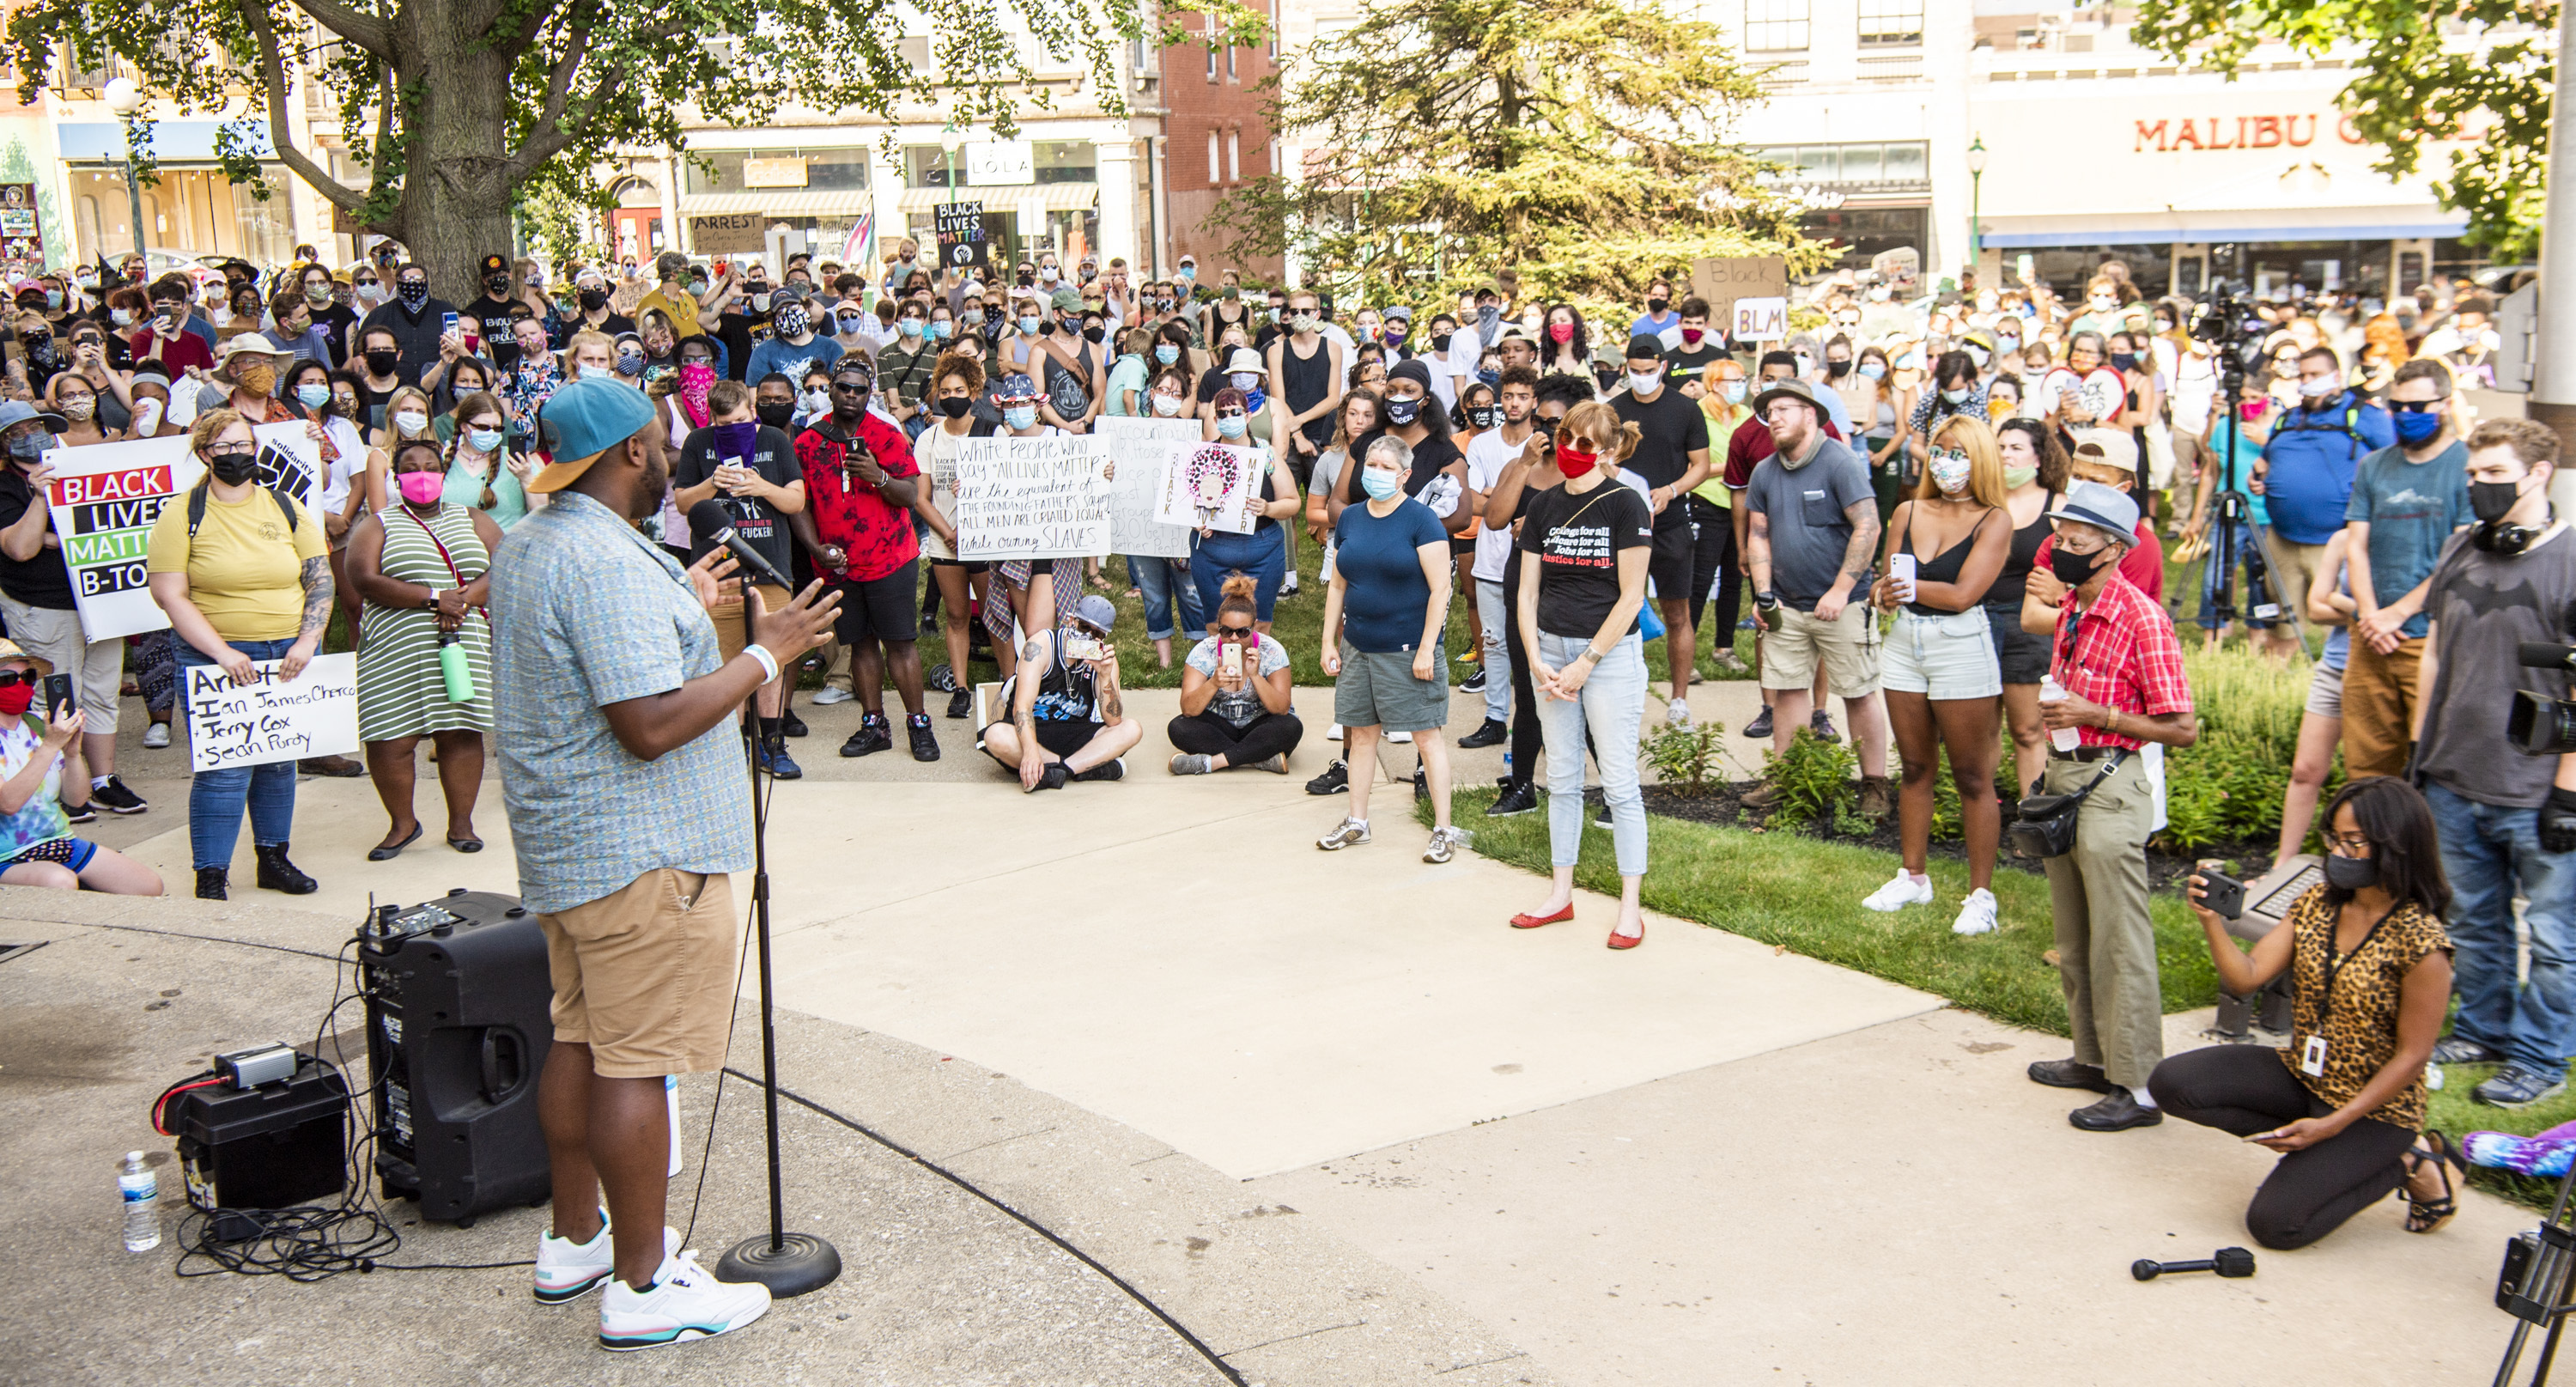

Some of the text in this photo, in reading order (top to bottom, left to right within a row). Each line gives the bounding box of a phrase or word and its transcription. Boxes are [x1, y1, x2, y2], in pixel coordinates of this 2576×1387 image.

[2135, 113, 2318, 152] MALIBU
[972, 160, 1030, 174] LOLA
[939, 201, 982, 218] BLACK
[695, 215, 759, 230] ARREST
[938, 216, 981, 232] LIVES
[937, 228, 986, 245] MATTER
[1710, 260, 1772, 284] Black
[618, 283, 644, 295] BLACK
[1739, 308, 1784, 335] BLM
[271, 438, 314, 476] solidarity
[957, 440, 1004, 462] White
[960, 464, 986, 481] say
[1017, 461, 1049, 478] LIVES
[64, 468, 163, 504] BLACK
[957, 477, 1100, 502] are the equivalent of
[960, 502, 980, 515] THE
[983, 500, 1035, 514] FOUNDING
[1035, 495, 1078, 511] FATHERS
[987, 514, 1011, 528] MEN
[1014, 513, 1032, 526] ARE
[1034, 510, 1072, 525] CREATED
[741, 526, 774, 538] FUCKER!
[998, 536, 1040, 553] owning
[1042, 526, 1097, 549] SLAVES
[1579, 537, 1595, 547] for
[1595, 536, 1610, 547] all
[1580, 526, 1595, 537] for
[1595, 526, 1610, 537] all
[69, 529, 149, 564] MATT
[1554, 546, 1610, 557] Jobs for all
[1542, 552, 1614, 567] Justice for all.
[81, 563, 149, 596] B-TO
[196, 698, 247, 719] Ian
[254, 691, 311, 709] James
[202, 715, 291, 745] Jerry Cox
[205, 740, 263, 767] Sean
